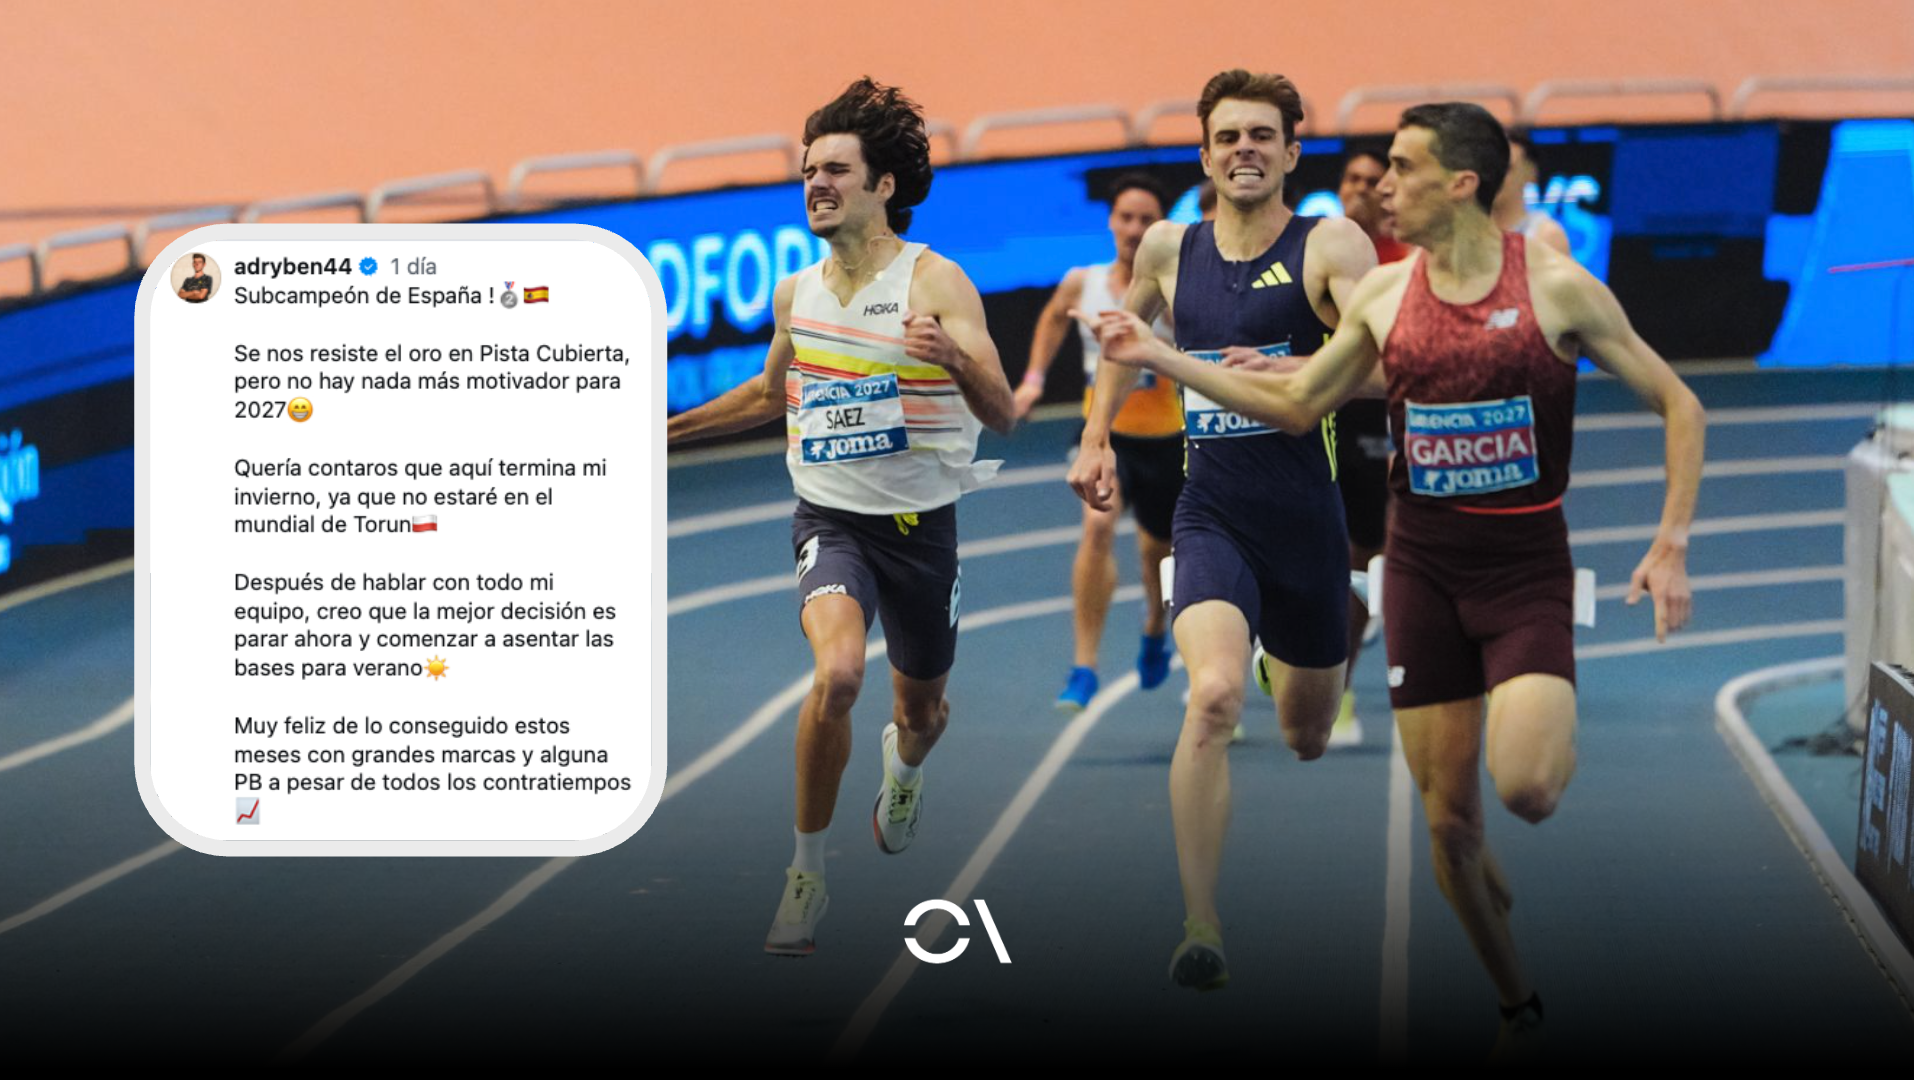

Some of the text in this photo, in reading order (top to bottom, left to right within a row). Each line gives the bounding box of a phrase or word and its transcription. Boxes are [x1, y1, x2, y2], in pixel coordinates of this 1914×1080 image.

[863, 302, 898, 316] HOKA
[854, 380, 891, 397] 2027
[826, 407, 865, 429] SAEZ
[1482, 405, 1525, 426] 2027
[1411, 432, 1528, 465] GARCIA
